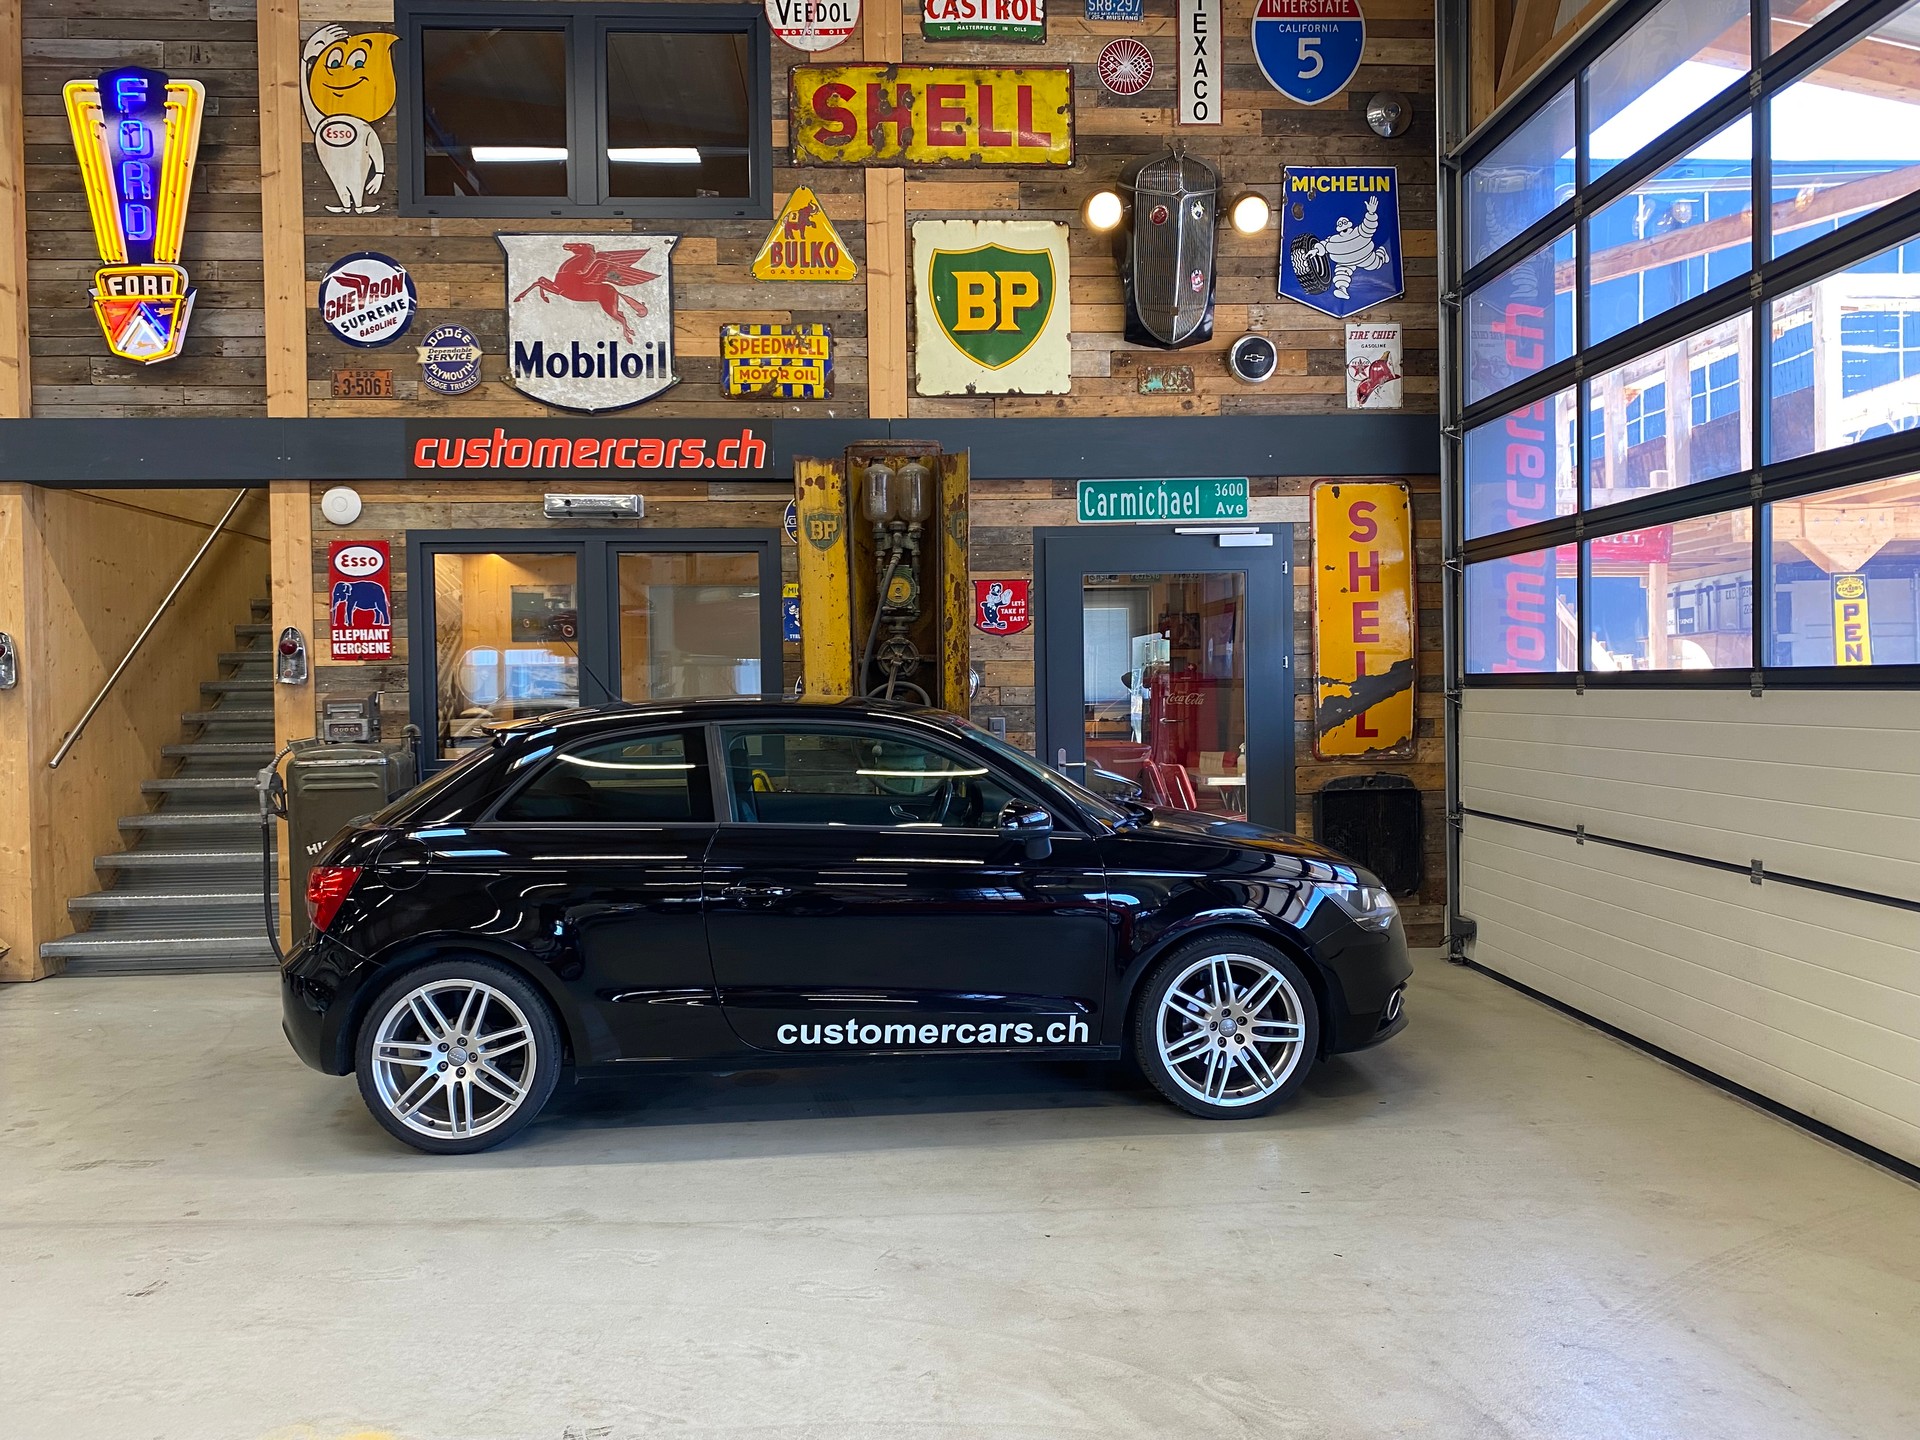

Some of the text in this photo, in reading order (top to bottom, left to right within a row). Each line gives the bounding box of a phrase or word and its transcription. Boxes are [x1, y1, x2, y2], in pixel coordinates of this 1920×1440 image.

[774, 0, 852, 25] VEEDOL
[925, 0, 1041, 22] CASTROL
[1266, 0, 1350, 13] INTERSTATE
[1278, 23, 1339, 33] CALIFORNIA
[1297, 37, 1324, 79] 5
[812, 83, 1052, 148] SHELL
[117, 78, 153, 241] FORD
[1291, 175, 1390, 193] MICHELIN
[770, 241, 839, 269] BULKO
[108, 275, 173, 298] FORD
[325, 271, 404, 321] CHEVRON
[951, 271, 1041, 333] BP
[340, 298, 407, 333] SUPREME
[359, 317, 398, 338] GASOLINE
[427, 328, 472, 346] DODGE
[1349, 330, 1397, 340] FIRE CHIEF
[426, 353, 472, 361] SERVICE
[729, 336, 824, 357] SPEEDWELL
[514, 340, 666, 379] Mobiloil
[426, 374, 477, 390] DODGE TRUCKS
[428, 362, 474, 381] PLYMOUTH
[738, 368, 817, 382] MOTOR OIL
[414, 427, 766, 470] customercars.ch
[1084, 483, 1244, 517] Carmichael 3600
[1215, 501, 1244, 515] Ave
[810, 520, 838, 540] BP
[1348, 501, 1380, 738] SHELL
[333, 629, 390, 642] ELEPHANT
[333, 641, 391, 655] KEROSENE
[776, 1015, 1089, 1045] customercars.ch
